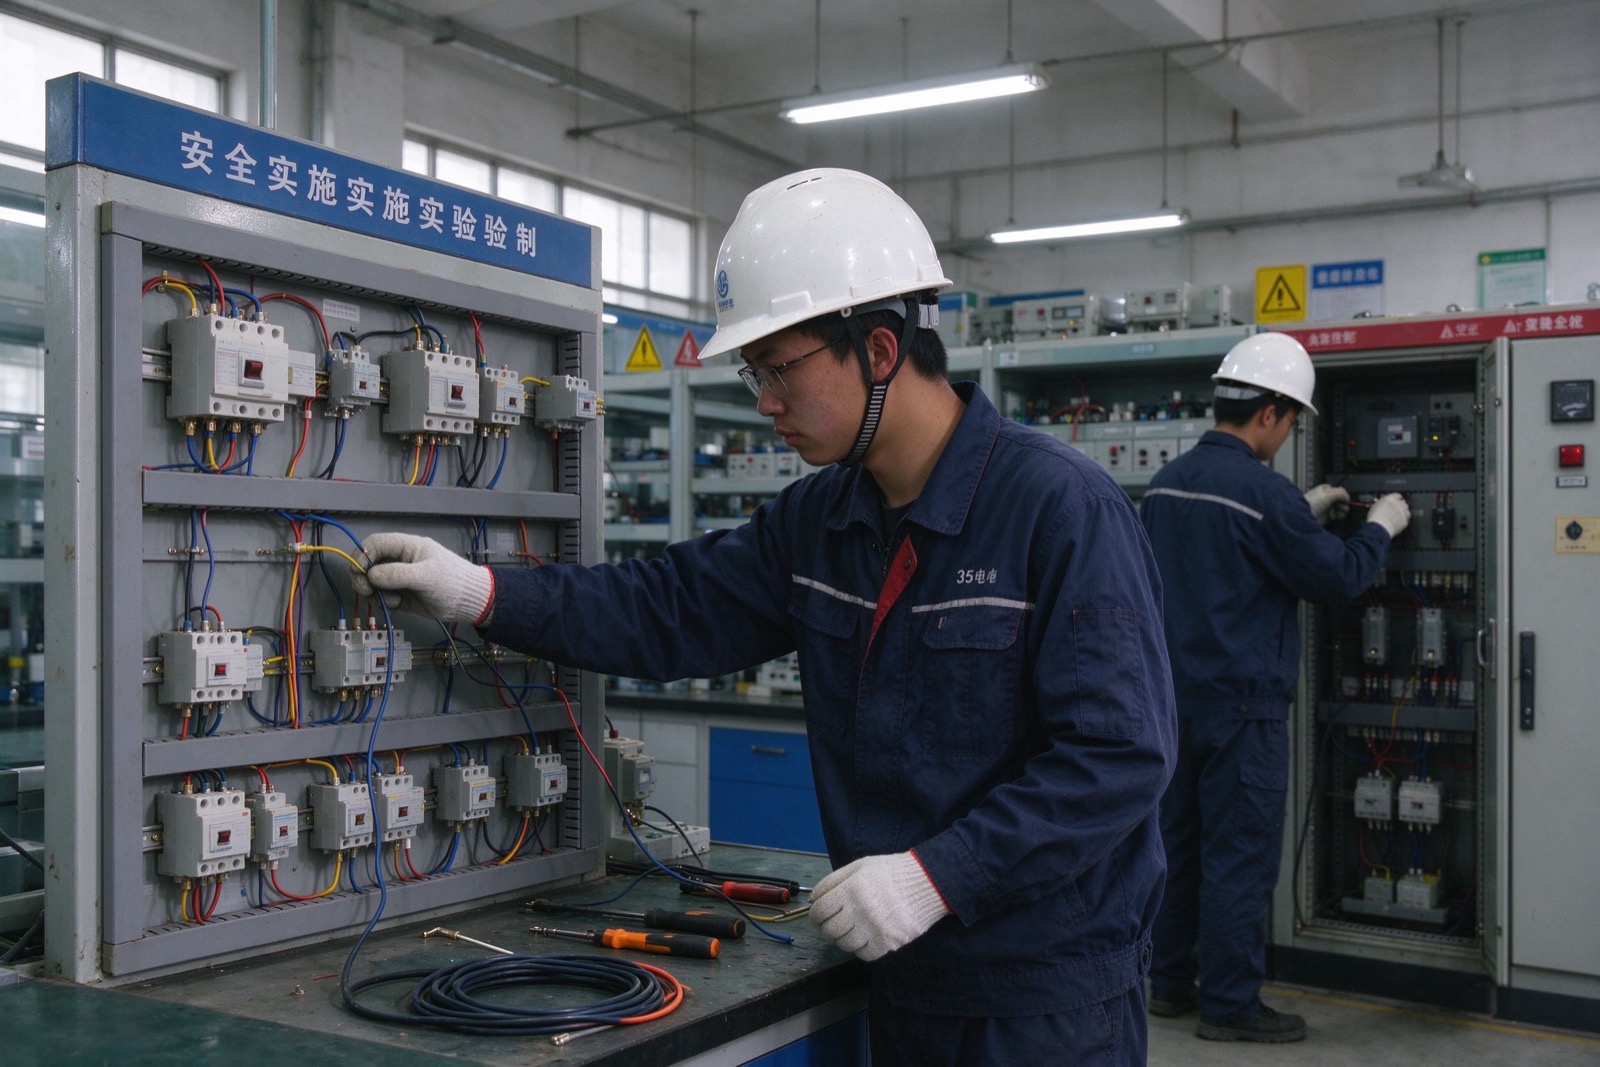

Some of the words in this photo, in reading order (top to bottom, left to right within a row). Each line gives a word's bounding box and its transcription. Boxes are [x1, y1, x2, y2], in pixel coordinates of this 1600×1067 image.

[180, 130, 537, 258] 安全实施实施实验验制
